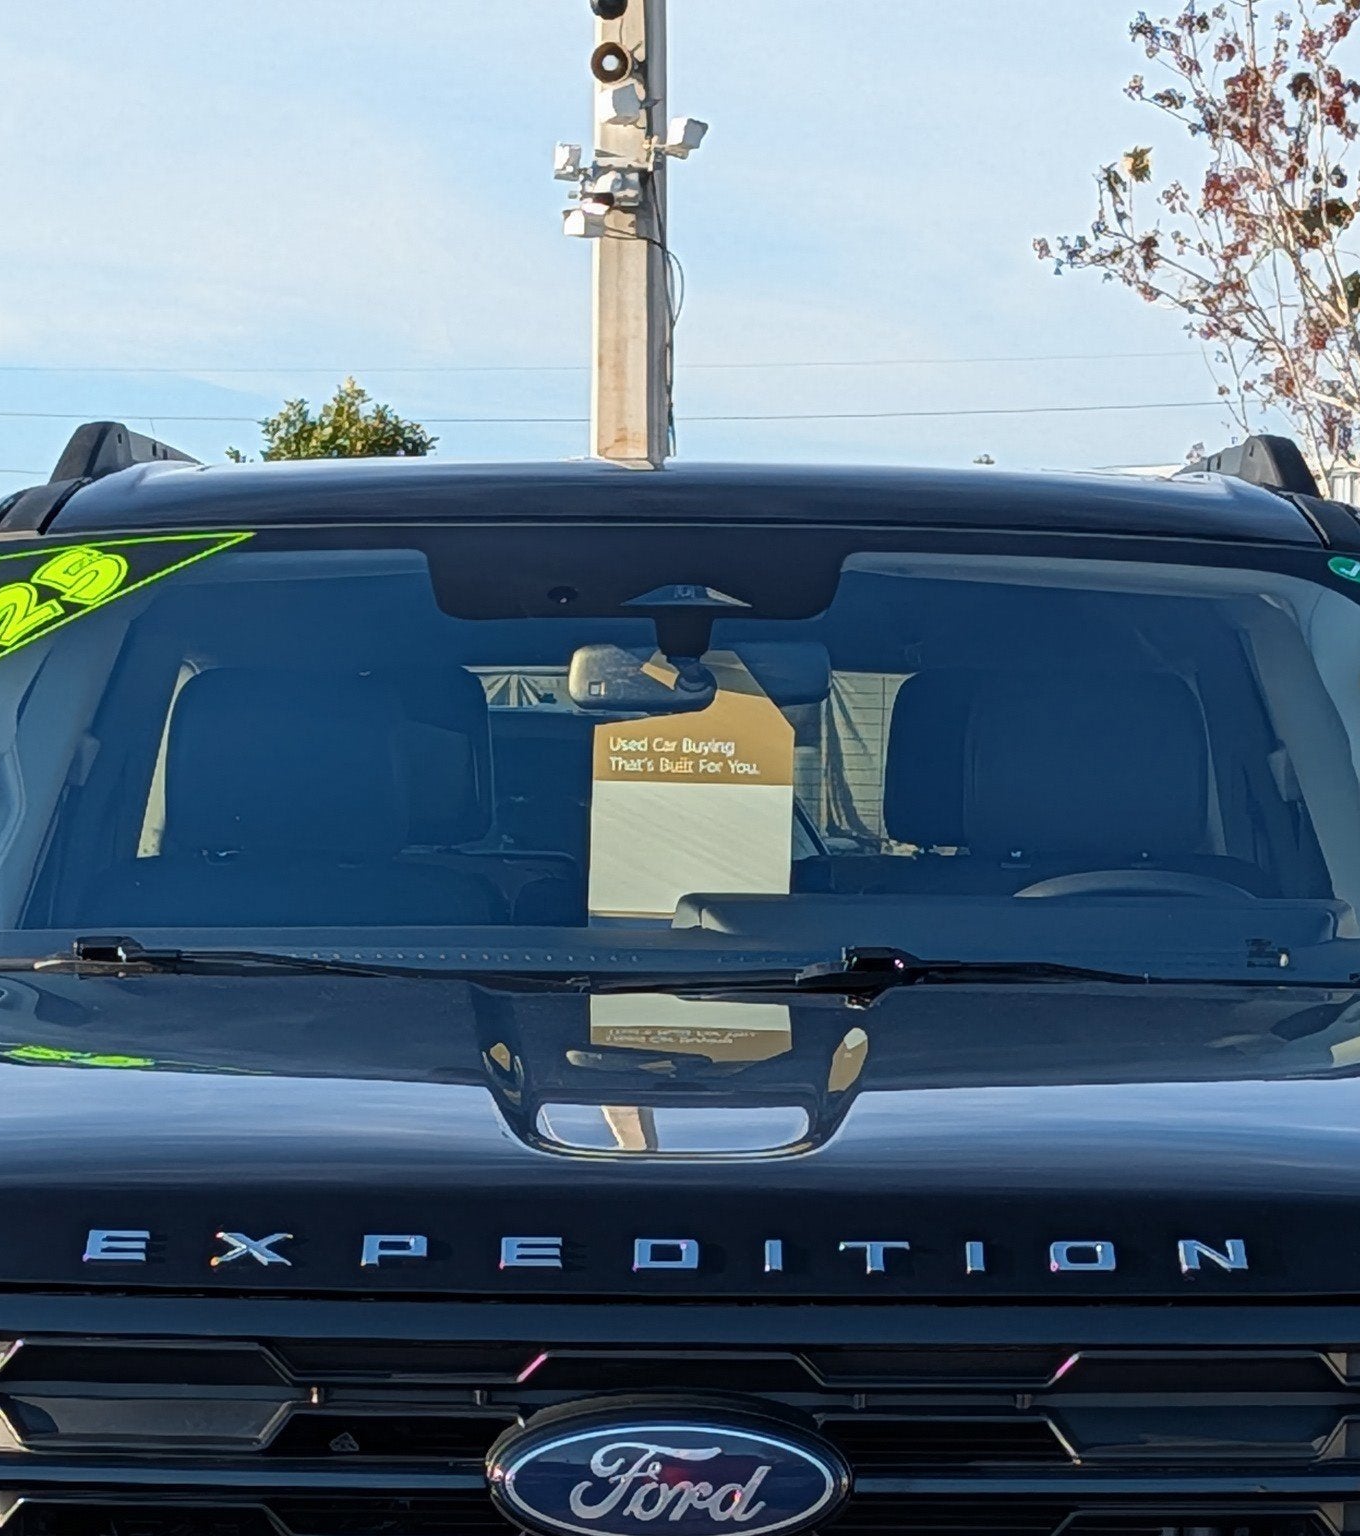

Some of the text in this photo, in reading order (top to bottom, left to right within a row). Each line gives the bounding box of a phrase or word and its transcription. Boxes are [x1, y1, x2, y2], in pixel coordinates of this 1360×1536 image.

[608, 736, 736, 757] Used Car Buying
[609, 756, 654, 772] That's
[659, 757, 694, 773] Built
[699, 759, 723, 773] For
[83, 1229, 1248, 1272] EXPEDITION
[569, 1442, 772, 1521] Ford
